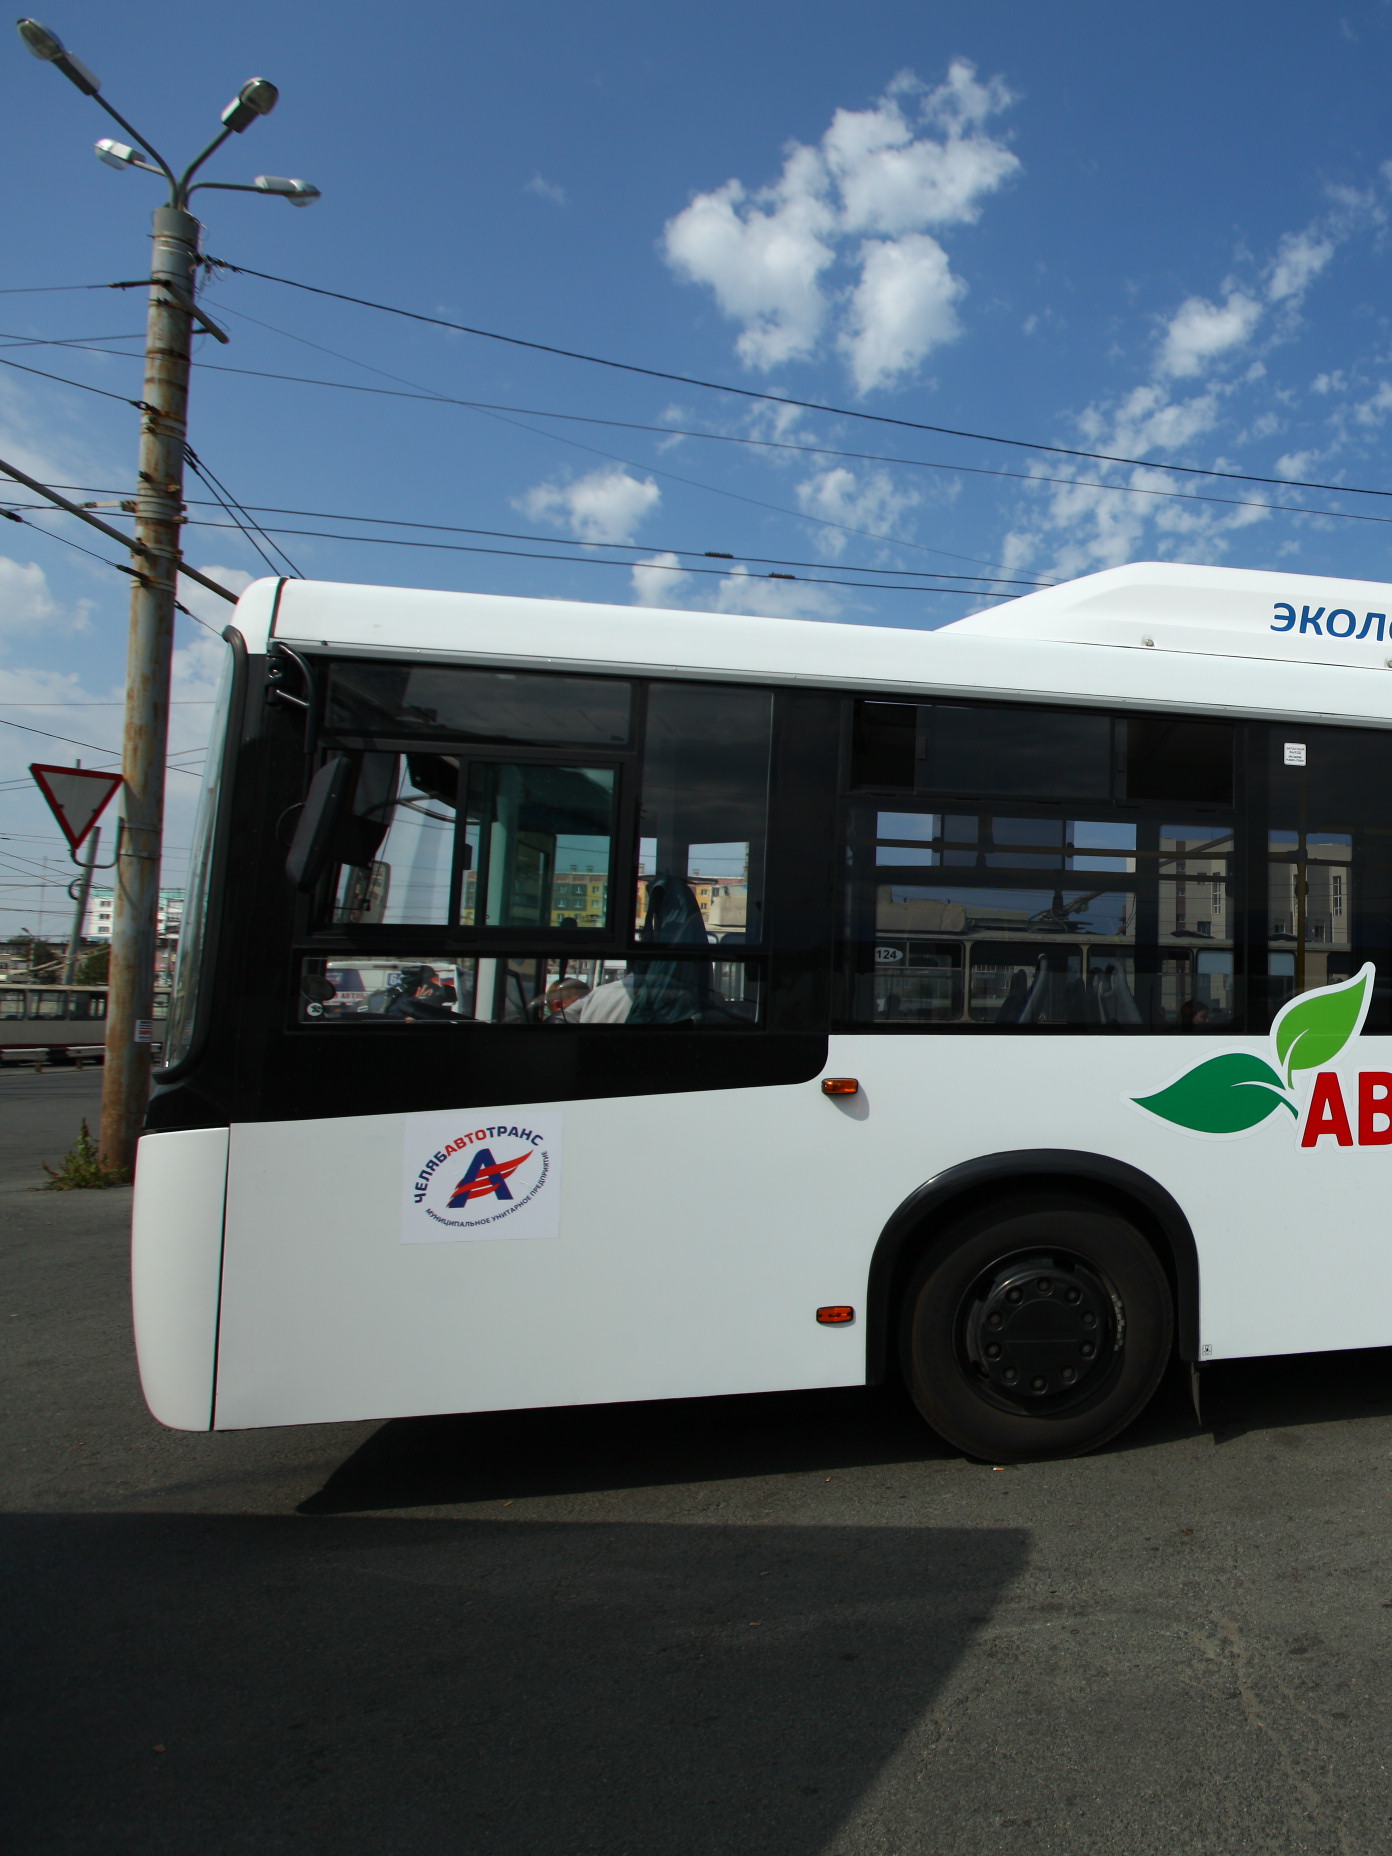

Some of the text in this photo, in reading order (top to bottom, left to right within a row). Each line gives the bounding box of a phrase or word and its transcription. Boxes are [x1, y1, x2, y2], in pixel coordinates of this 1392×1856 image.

[876, 949, 897, 960] 124
[414, 1125, 544, 1204] ЧЕЛЯБАВТОТРАНС
[425, 1151, 549, 1227] МУНИЦИПАЛЬНОЕ УНИТАРНОЕ ПРЕДПРИЯТИЕ
